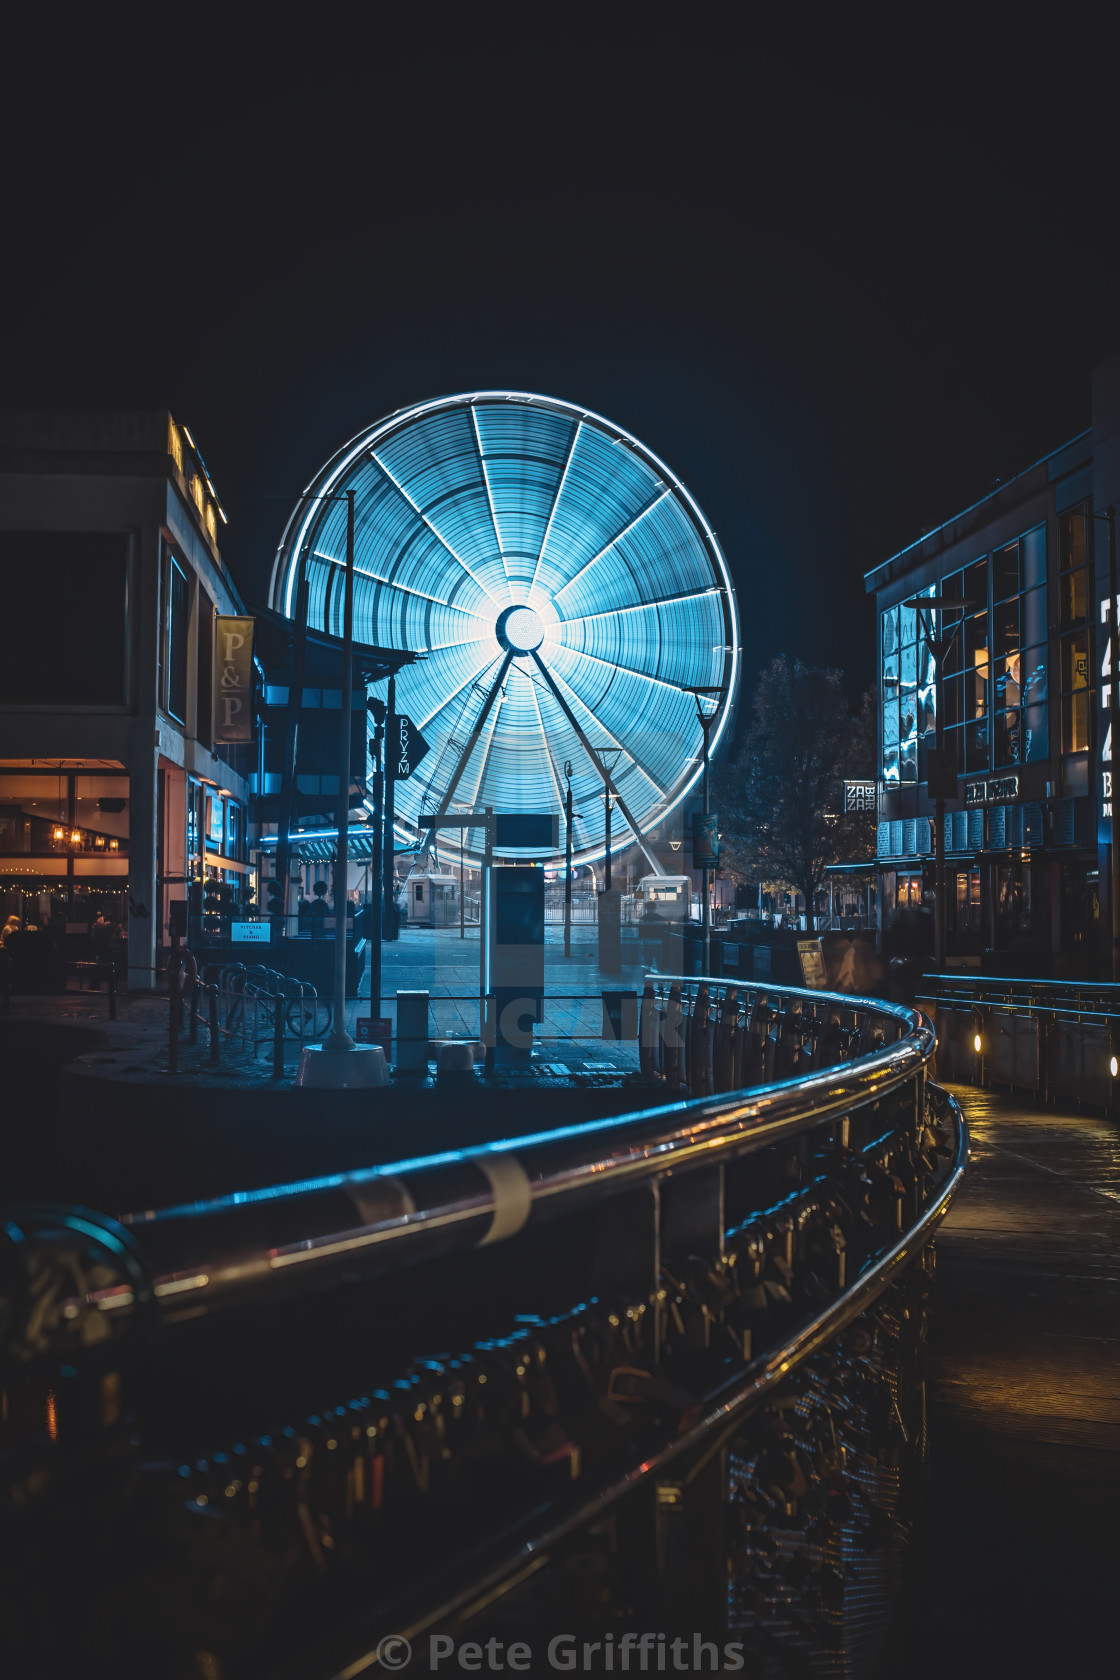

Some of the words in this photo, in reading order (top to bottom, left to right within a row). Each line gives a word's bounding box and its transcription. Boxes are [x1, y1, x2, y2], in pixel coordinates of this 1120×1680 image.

[398, 718, 410, 774] PRYZM
[847, 785, 865, 798] ZA
[865, 786, 876, 810] BAR
[847, 799, 865, 811] ZA
